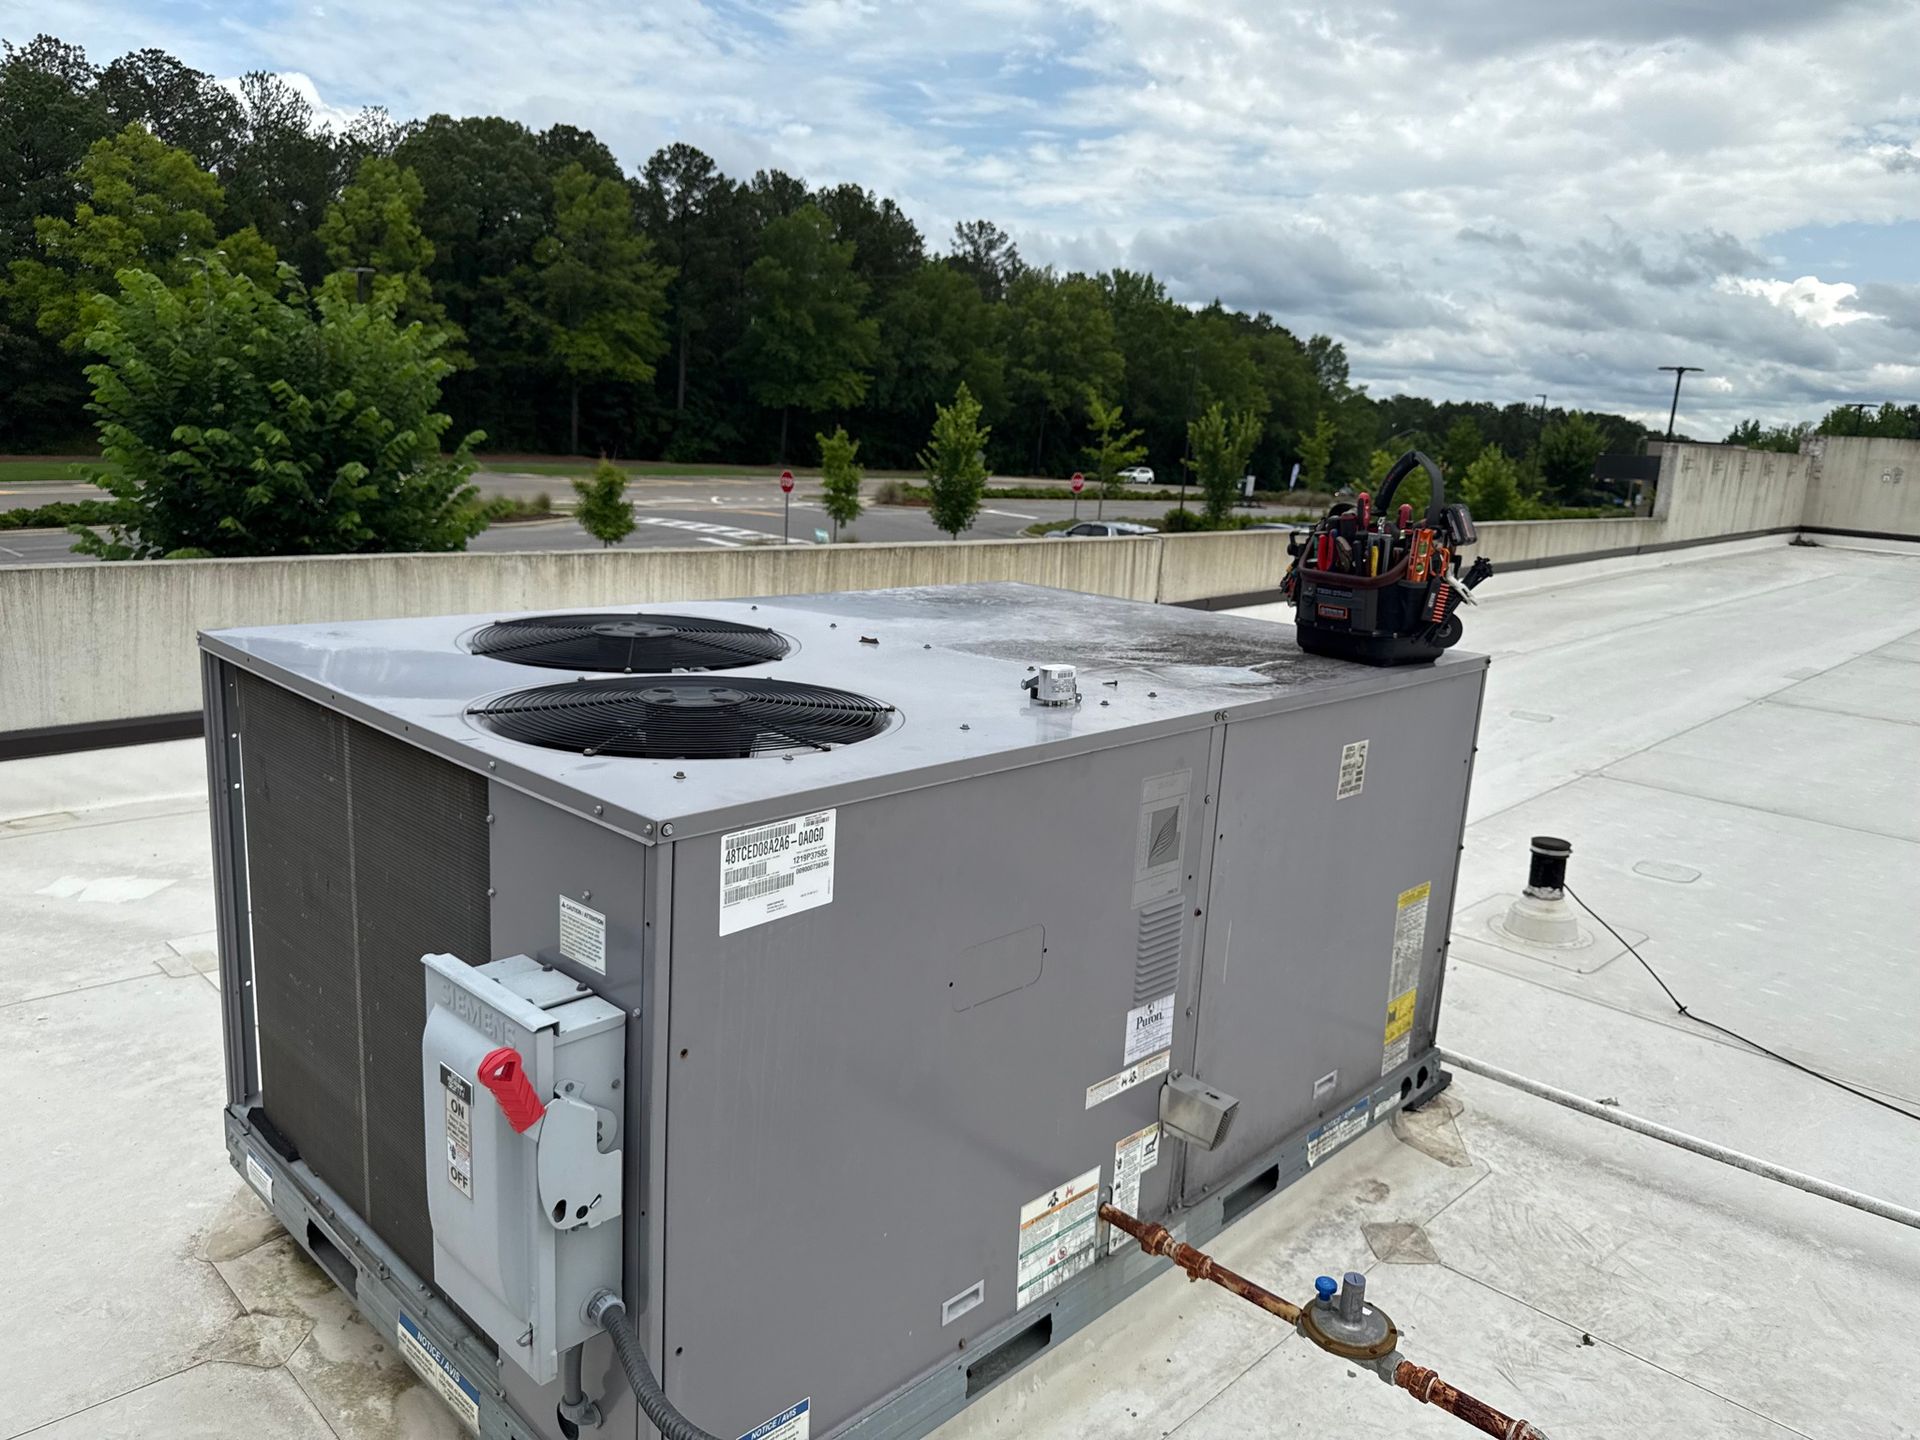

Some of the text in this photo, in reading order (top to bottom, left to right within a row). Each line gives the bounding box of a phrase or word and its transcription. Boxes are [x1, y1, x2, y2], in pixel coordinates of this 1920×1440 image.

[440, 982, 517, 1048] SIEMENS
[1136, 1011, 1163, 1030] Puron
[451, 1099, 464, 1119] ON
[450, 1166, 468, 1189] OFF
[417, 1331, 441, 1363] NOTICE
[444, 1361, 461, 1383] AVIS
[750, 1419, 777, 1440] NOTICE
[781, 1408, 797, 1424] AVIS
